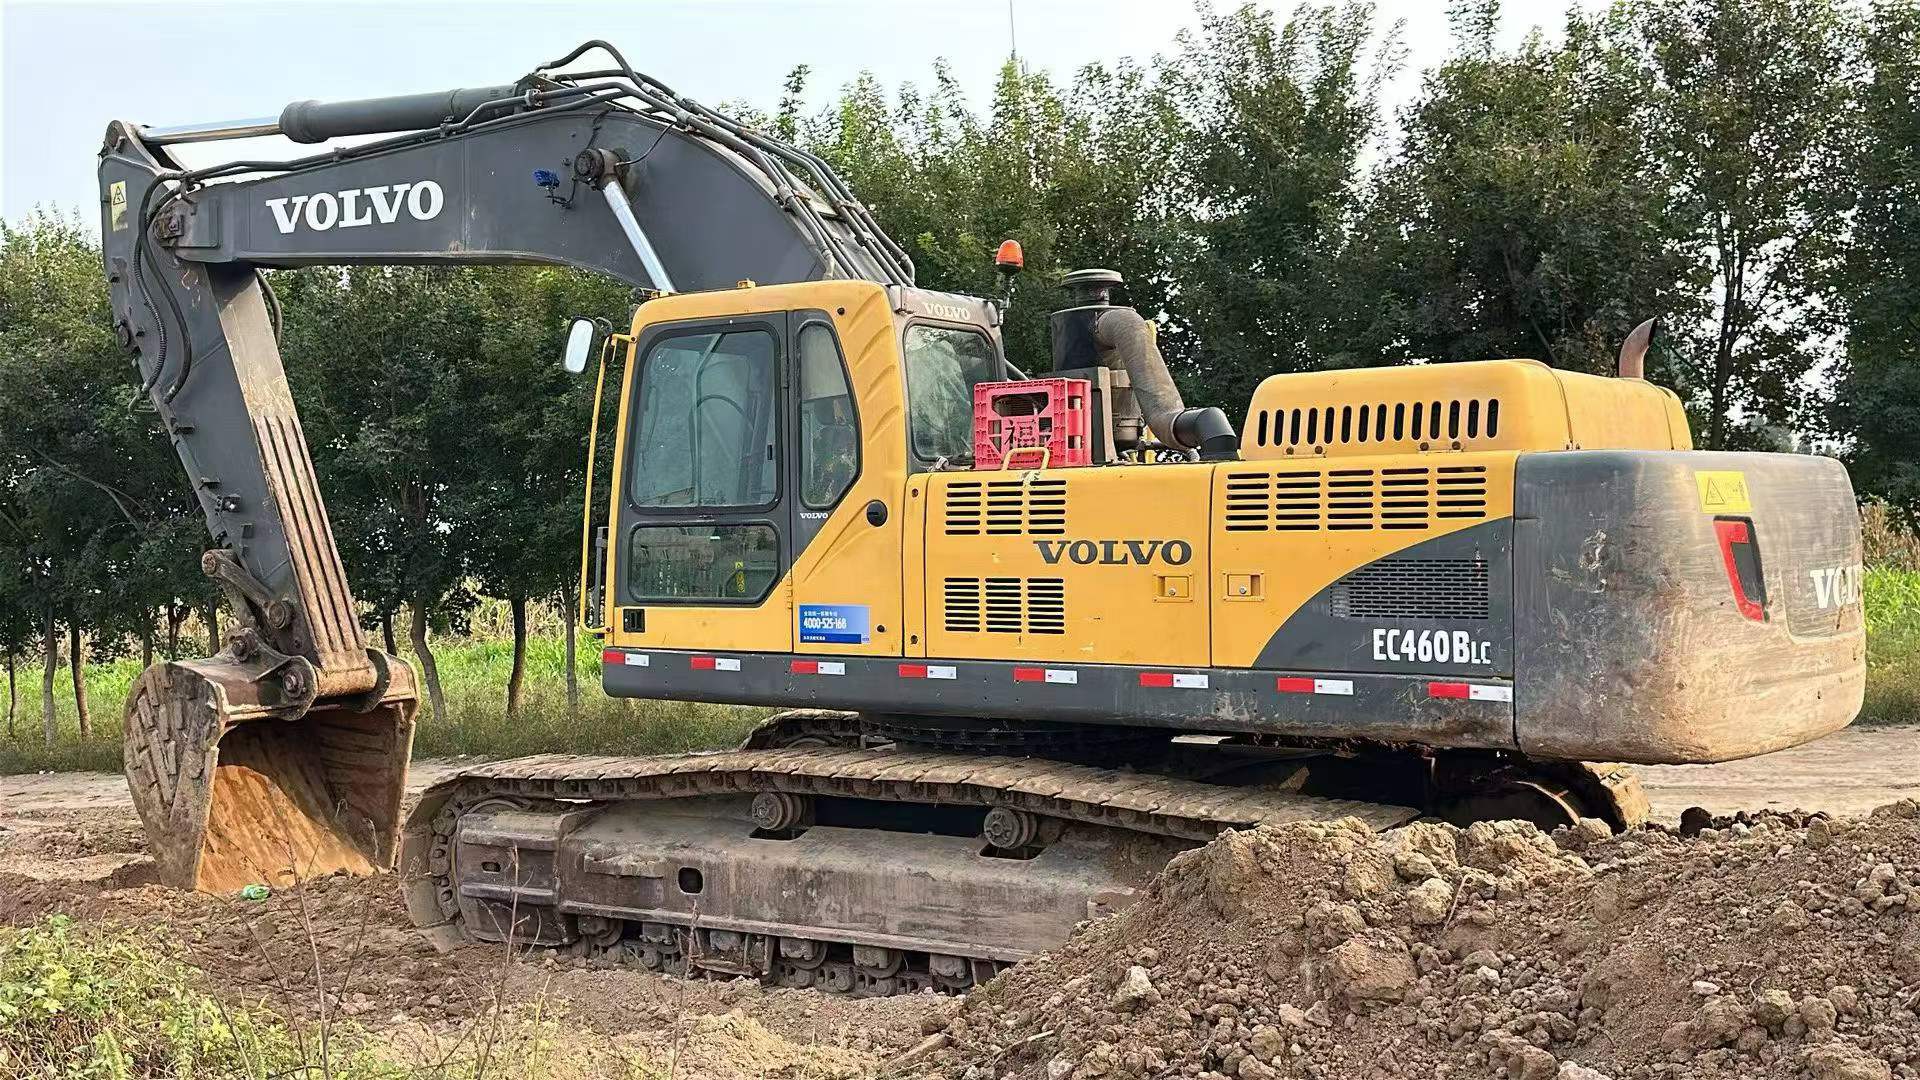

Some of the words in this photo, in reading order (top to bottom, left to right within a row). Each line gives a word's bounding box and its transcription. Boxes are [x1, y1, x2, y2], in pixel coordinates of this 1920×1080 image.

[265, 180, 444, 234] VOLVO
[922, 302, 971, 321] VOLVO
[1033, 540, 1192, 566] VOLVO
